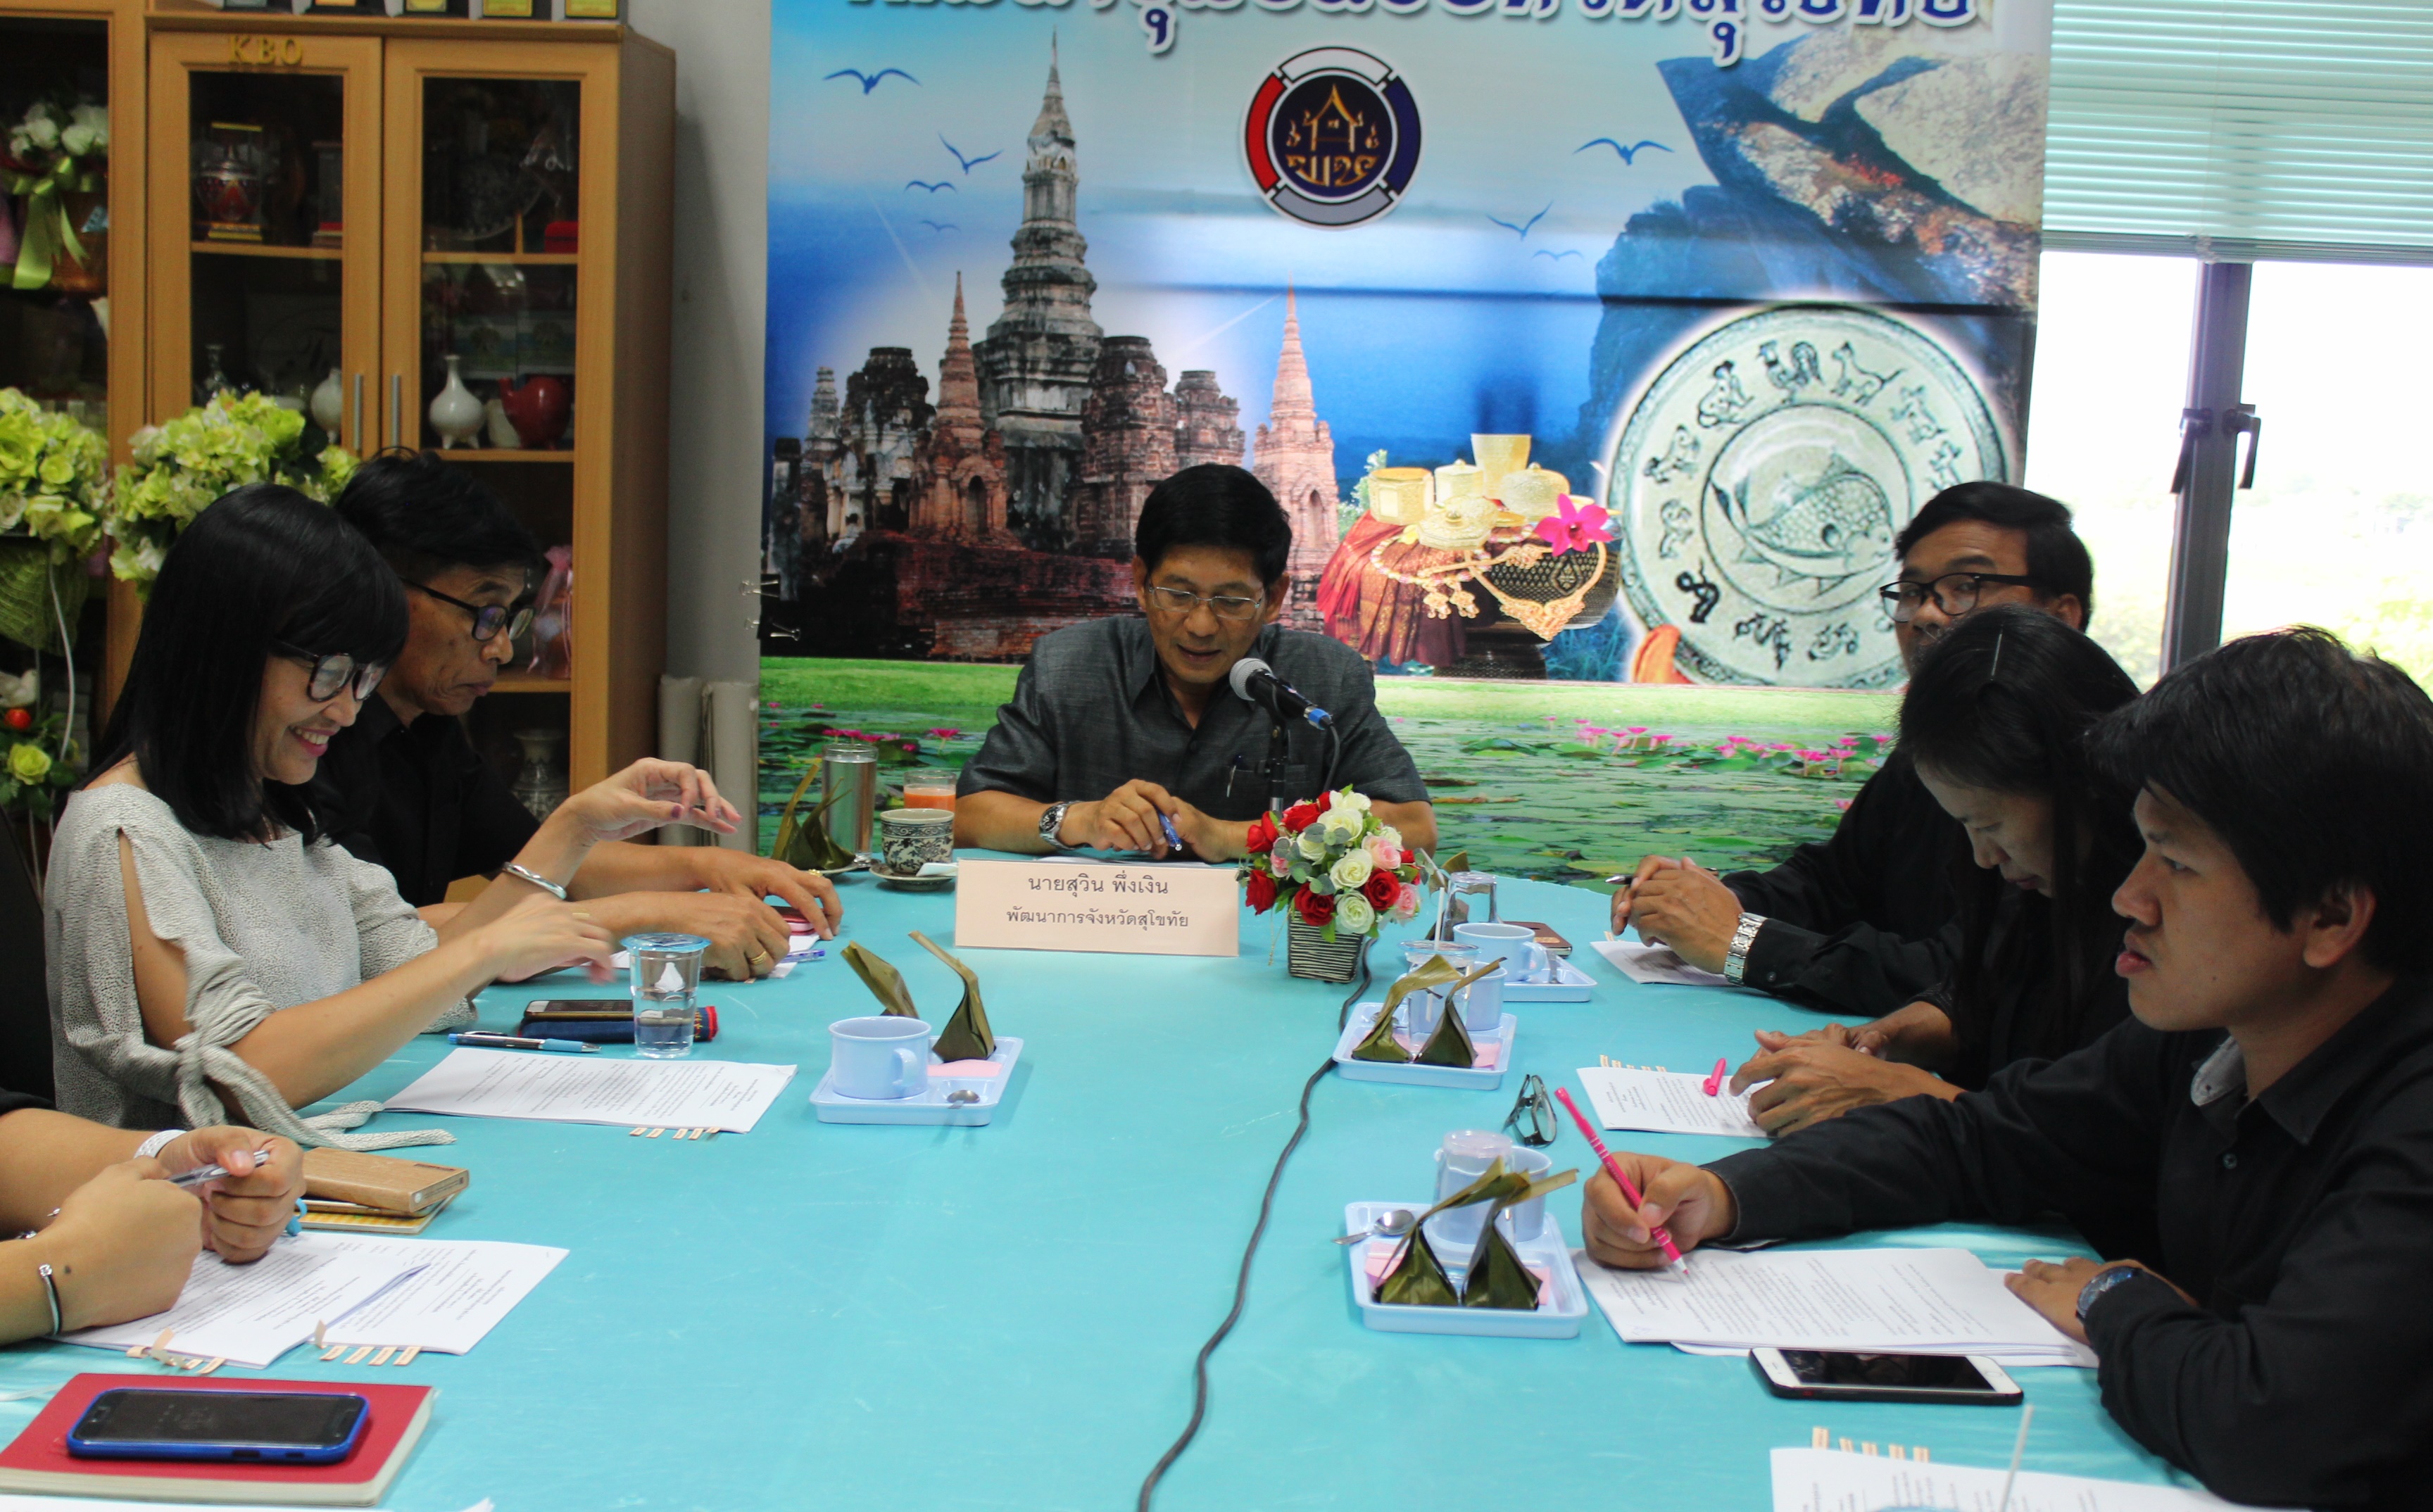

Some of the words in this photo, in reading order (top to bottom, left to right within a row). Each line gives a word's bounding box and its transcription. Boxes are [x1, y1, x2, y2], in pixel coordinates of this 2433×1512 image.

[229, 35, 303, 65] KBO
[1028, 872, 1104, 897] นายสุวิน
[1112, 869, 1169, 895] พึ่งเงิน
[1006, 905, 1189, 931] พัฒนาการจังหวัดสุโขทัย
